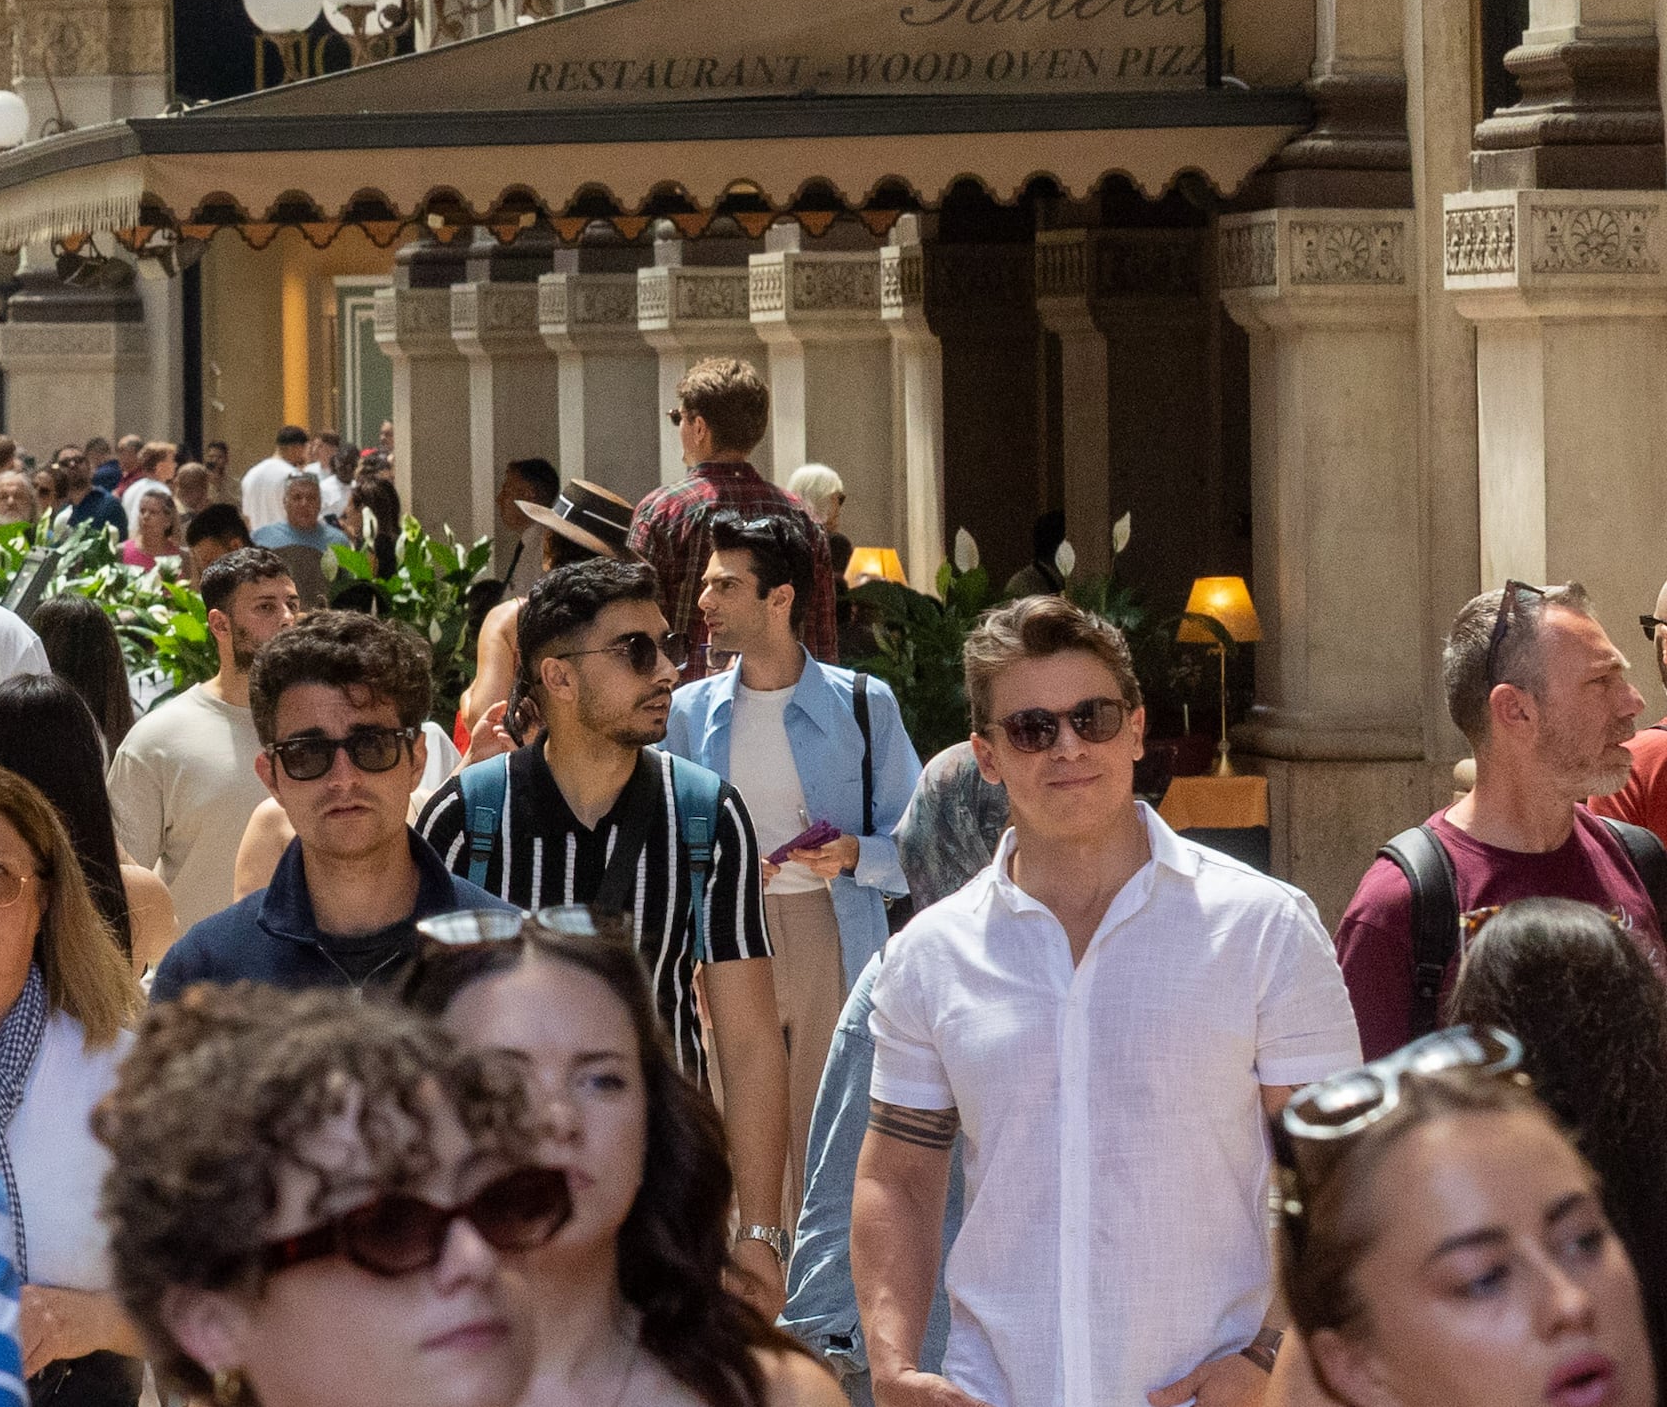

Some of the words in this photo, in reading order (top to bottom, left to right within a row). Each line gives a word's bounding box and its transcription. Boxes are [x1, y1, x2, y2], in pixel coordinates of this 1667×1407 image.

[527, 55, 809, 93] RESTAURANT
[845, 50, 971, 85] WOOD
[985, 47, 1105, 81] OVEN
